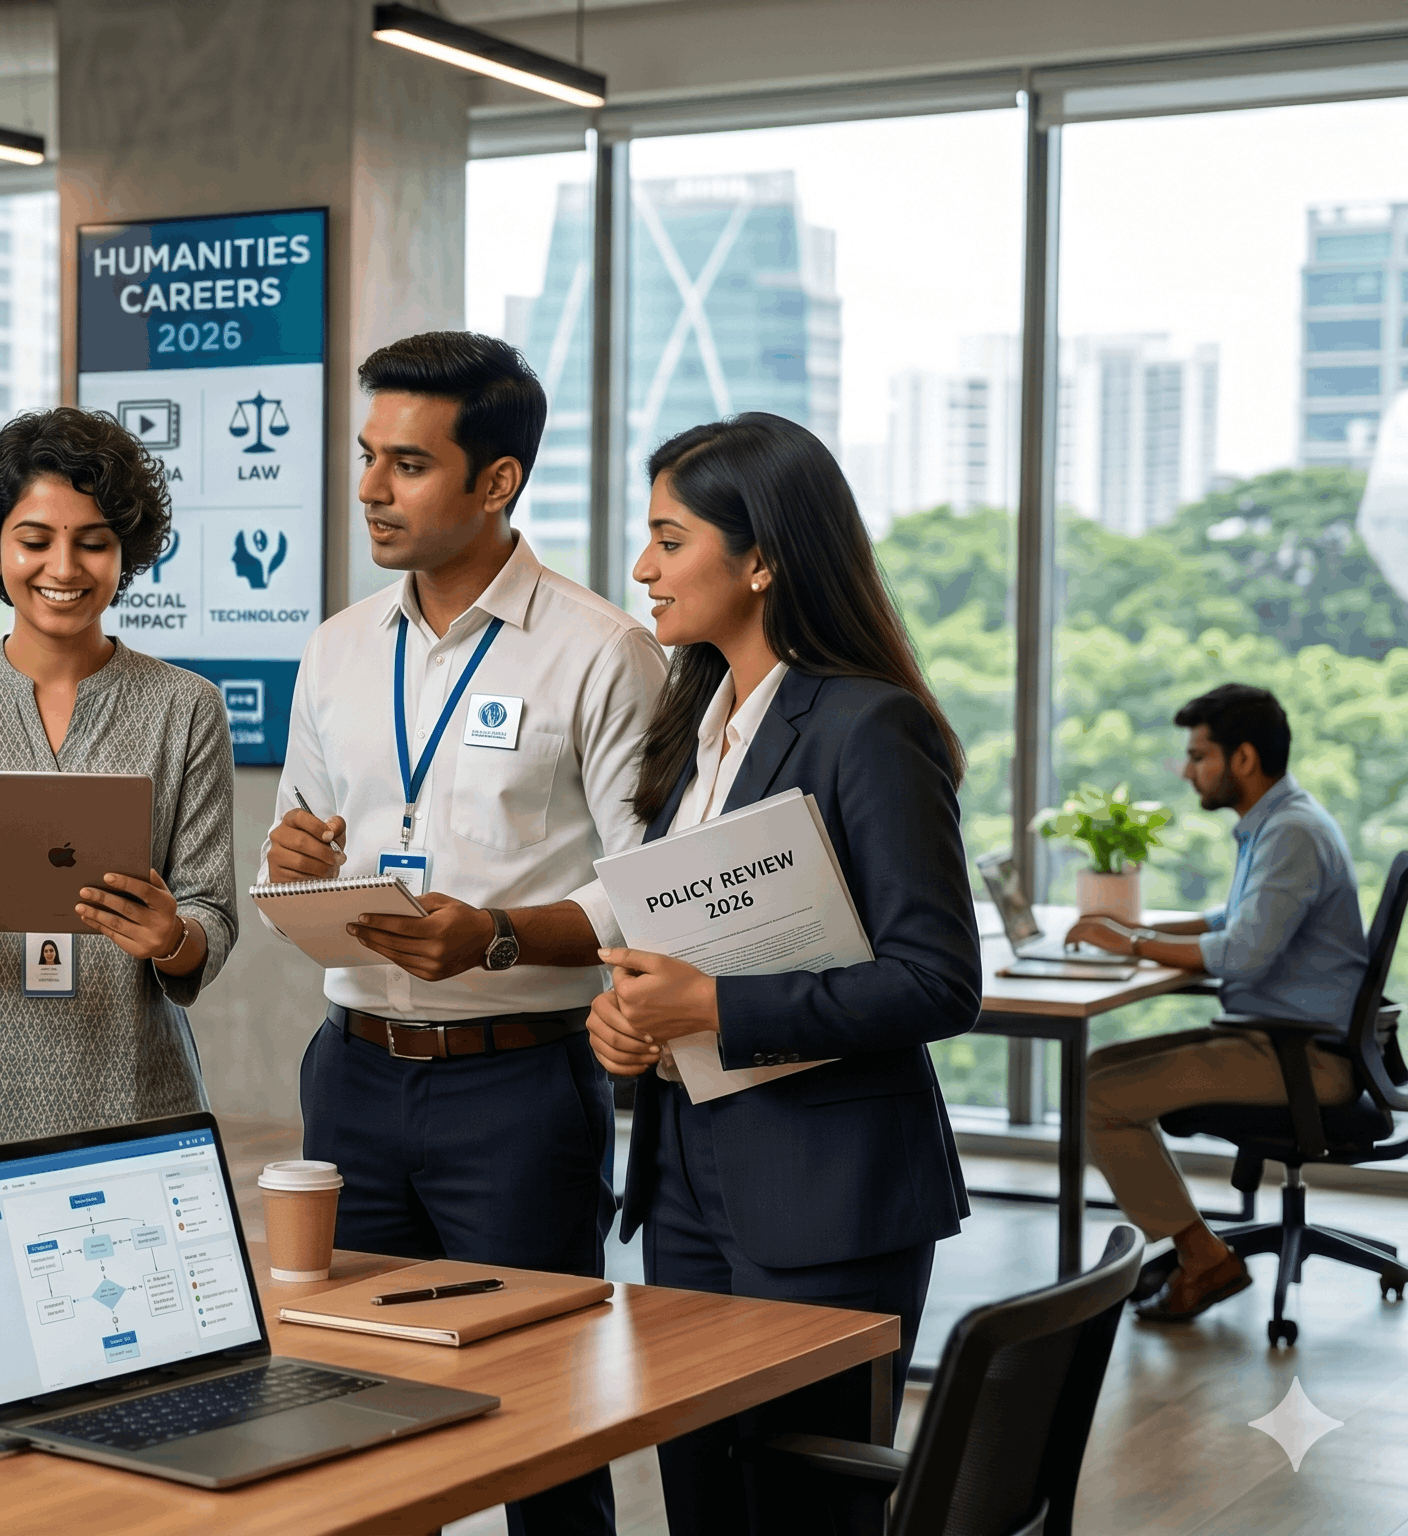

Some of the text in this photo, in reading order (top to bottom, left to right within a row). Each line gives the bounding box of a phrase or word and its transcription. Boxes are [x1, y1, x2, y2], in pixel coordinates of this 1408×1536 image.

[94, 235, 310, 277] HUMANITIES
[120, 277, 281, 313] CAREERS
[157, 321, 242, 352] 2026
[238, 465, 280, 480] LAW
[120, 614, 187, 629] IMPACT
[209, 609, 310, 623] TECHNOLOGY
[645, 850, 794, 913] POLICY REVIEW
[705, 890, 754, 919] 2026
